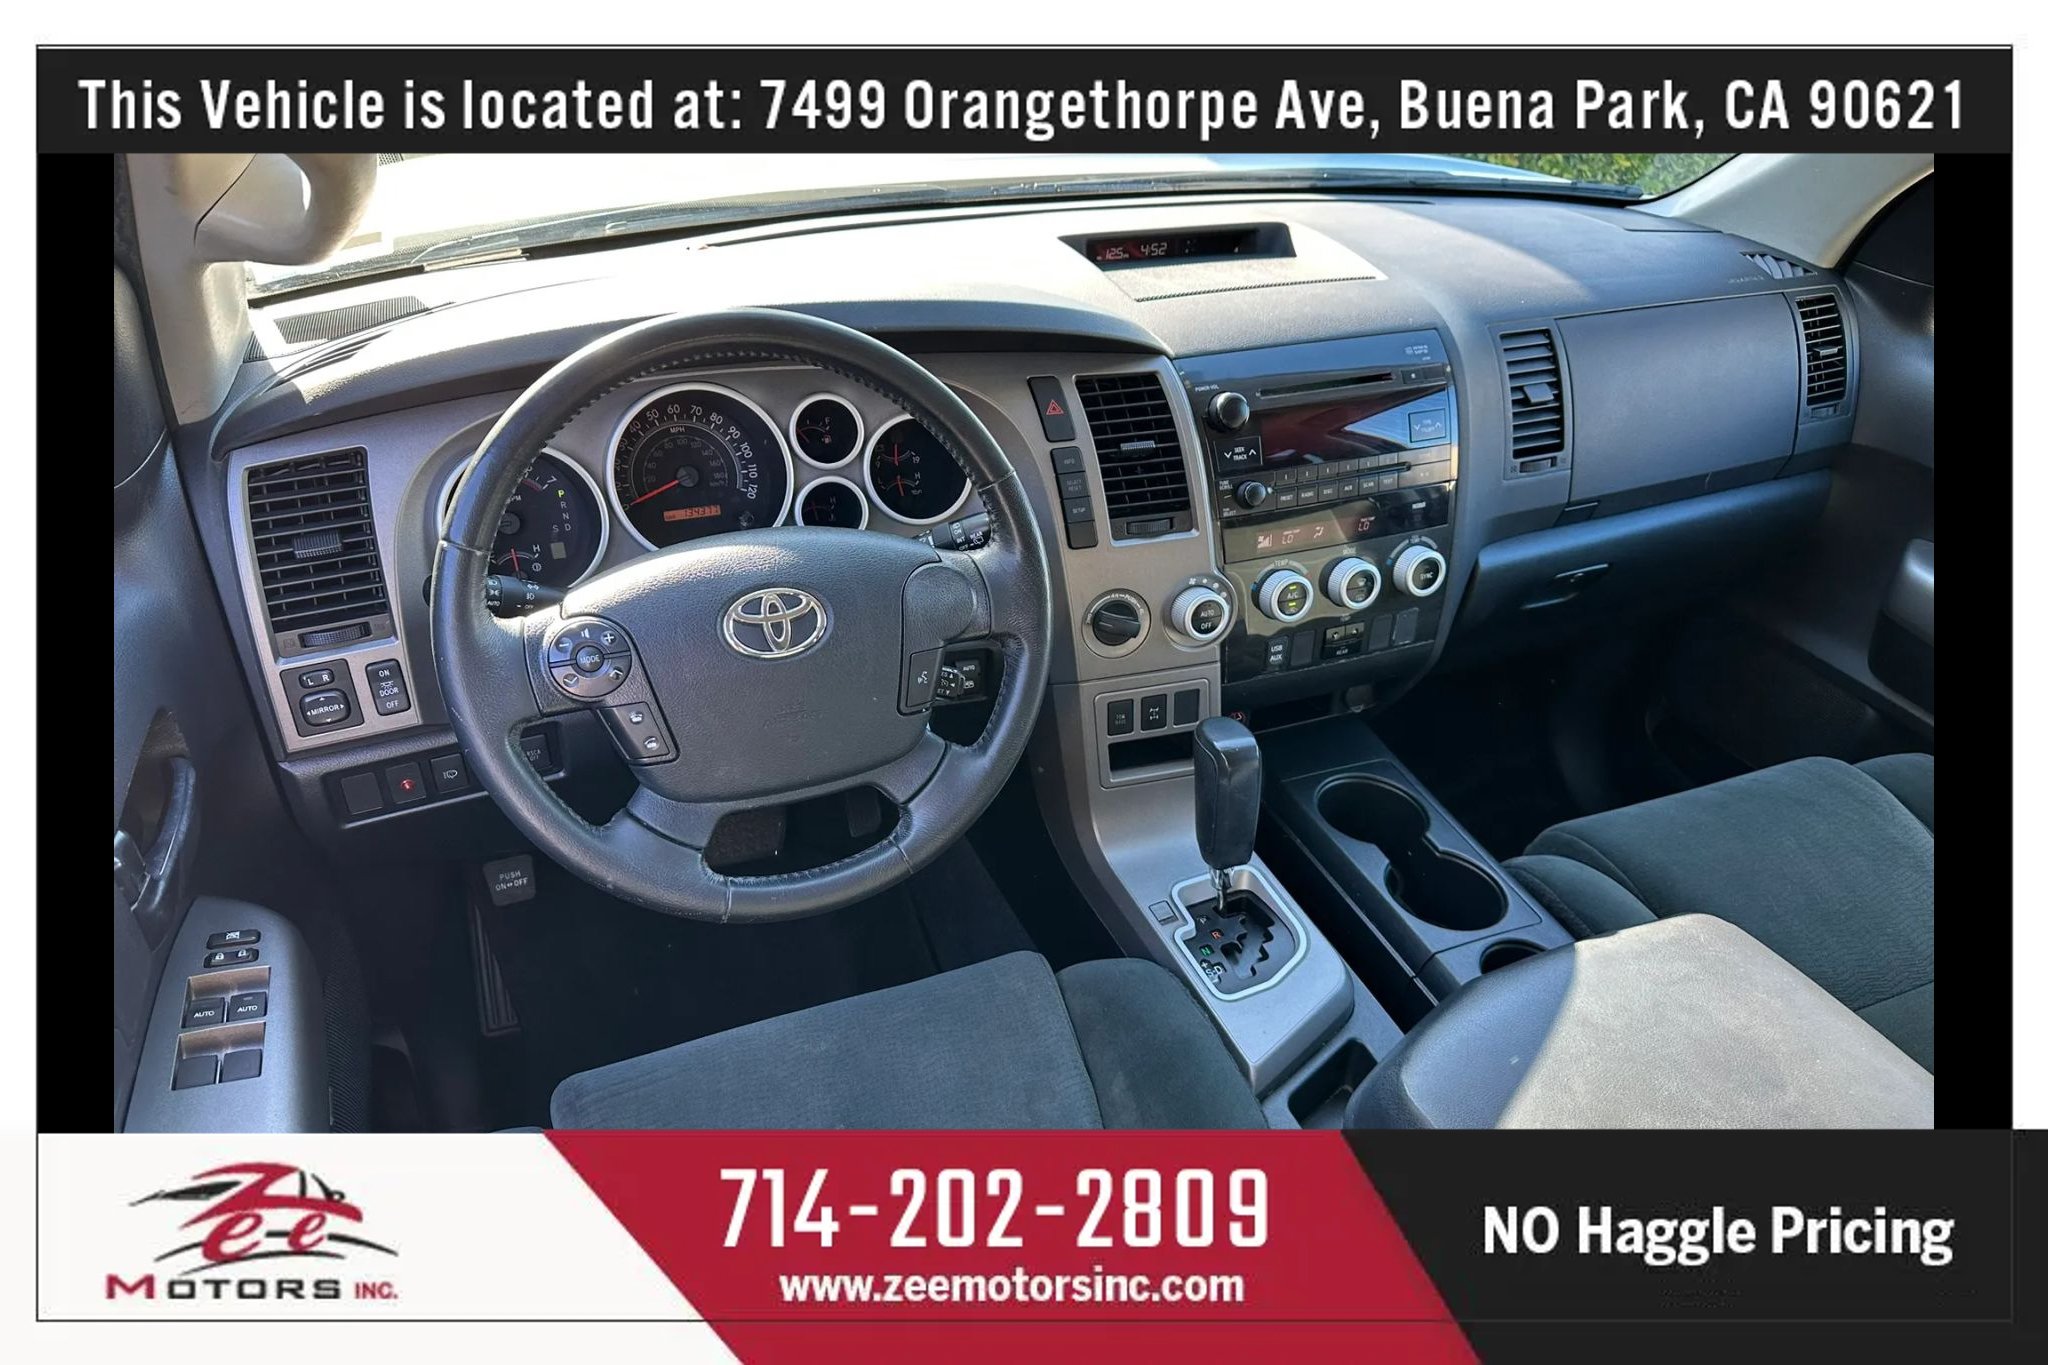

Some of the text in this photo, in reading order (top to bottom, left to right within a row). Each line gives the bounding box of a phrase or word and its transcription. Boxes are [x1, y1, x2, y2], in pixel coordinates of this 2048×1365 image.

[667, 404, 681, 414] 60
[690, 405, 703, 416] 70
[646, 409, 659, 420] 50
[709, 412, 723, 425] 80
[728, 426, 741, 439] 90
[740, 442, 753, 459] 100
[748, 464, 758, 478] 110
[747, 484, 758, 499] 120
[553, 525, 559, 533] S
[533, 544, 540, 552] H
[1286, 591, 1299, 599] A/C
[1200, 609, 1214, 617] AUTO
[1201, 622, 1211, 630] OFF
[579, 653, 600, 664] MODE
[1270, 653, 1283, 662] AUX
[379, 668, 390, 677] ON
[307, 678, 314, 686] L
[379, 686, 399, 697] DOOR
[311, 703, 340, 716] MIRROR
[386, 700, 400, 709] OFF
[499, 870, 521, 880] PUSH
[495, 878, 528, 891] ON OFF
[1211, 931, 1221, 939] R
[1201, 947, 1211, 956] N
[1214, 966, 1222, 974] D
